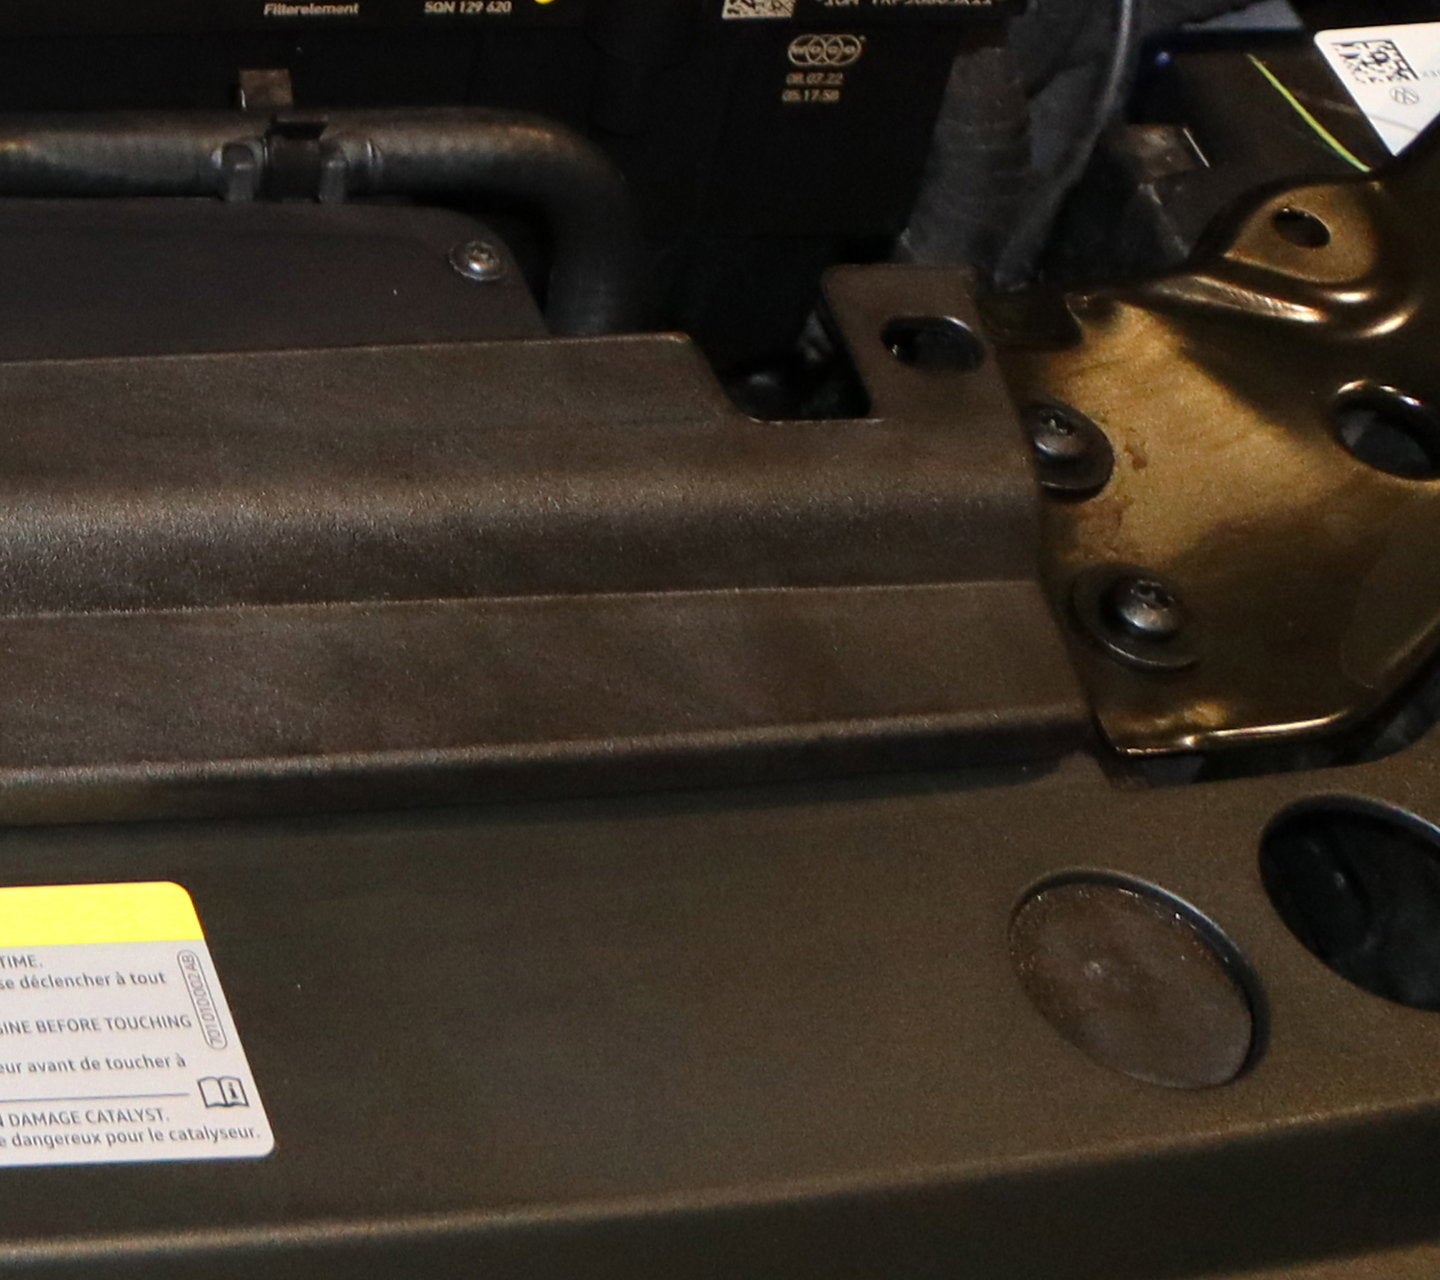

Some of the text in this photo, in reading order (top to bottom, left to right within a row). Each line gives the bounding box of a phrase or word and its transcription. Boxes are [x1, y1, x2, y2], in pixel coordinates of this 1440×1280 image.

[263, 2, 360, 16] Filterelement
[458, 1, 484, 13] 129
[486, 1, 513, 13] 620
[18, 971, 110, 989] déclencher
[115, 970, 126, 986] à
[128, 971, 166, 985] tout
[34, 1017, 101, 1034] BEFORE
[103, 1014, 192, 1031] TOUCHING
[27, 1058, 76, 1073] avant
[79, 1055, 101, 1071] de
[104, 1053, 170, 1070] toucher
[175, 1053, 186, 1068] à
[7, 1110, 80, 1127] DAMAGE
[84, 1107, 167, 1124] CATALYST.
[10, 1131, 101, 1149] dangereux
[104, 1131, 143, 1147] pour
[146, 1126, 164, 1142] le
[167, 1124, 260, 1144] catalyseur.
